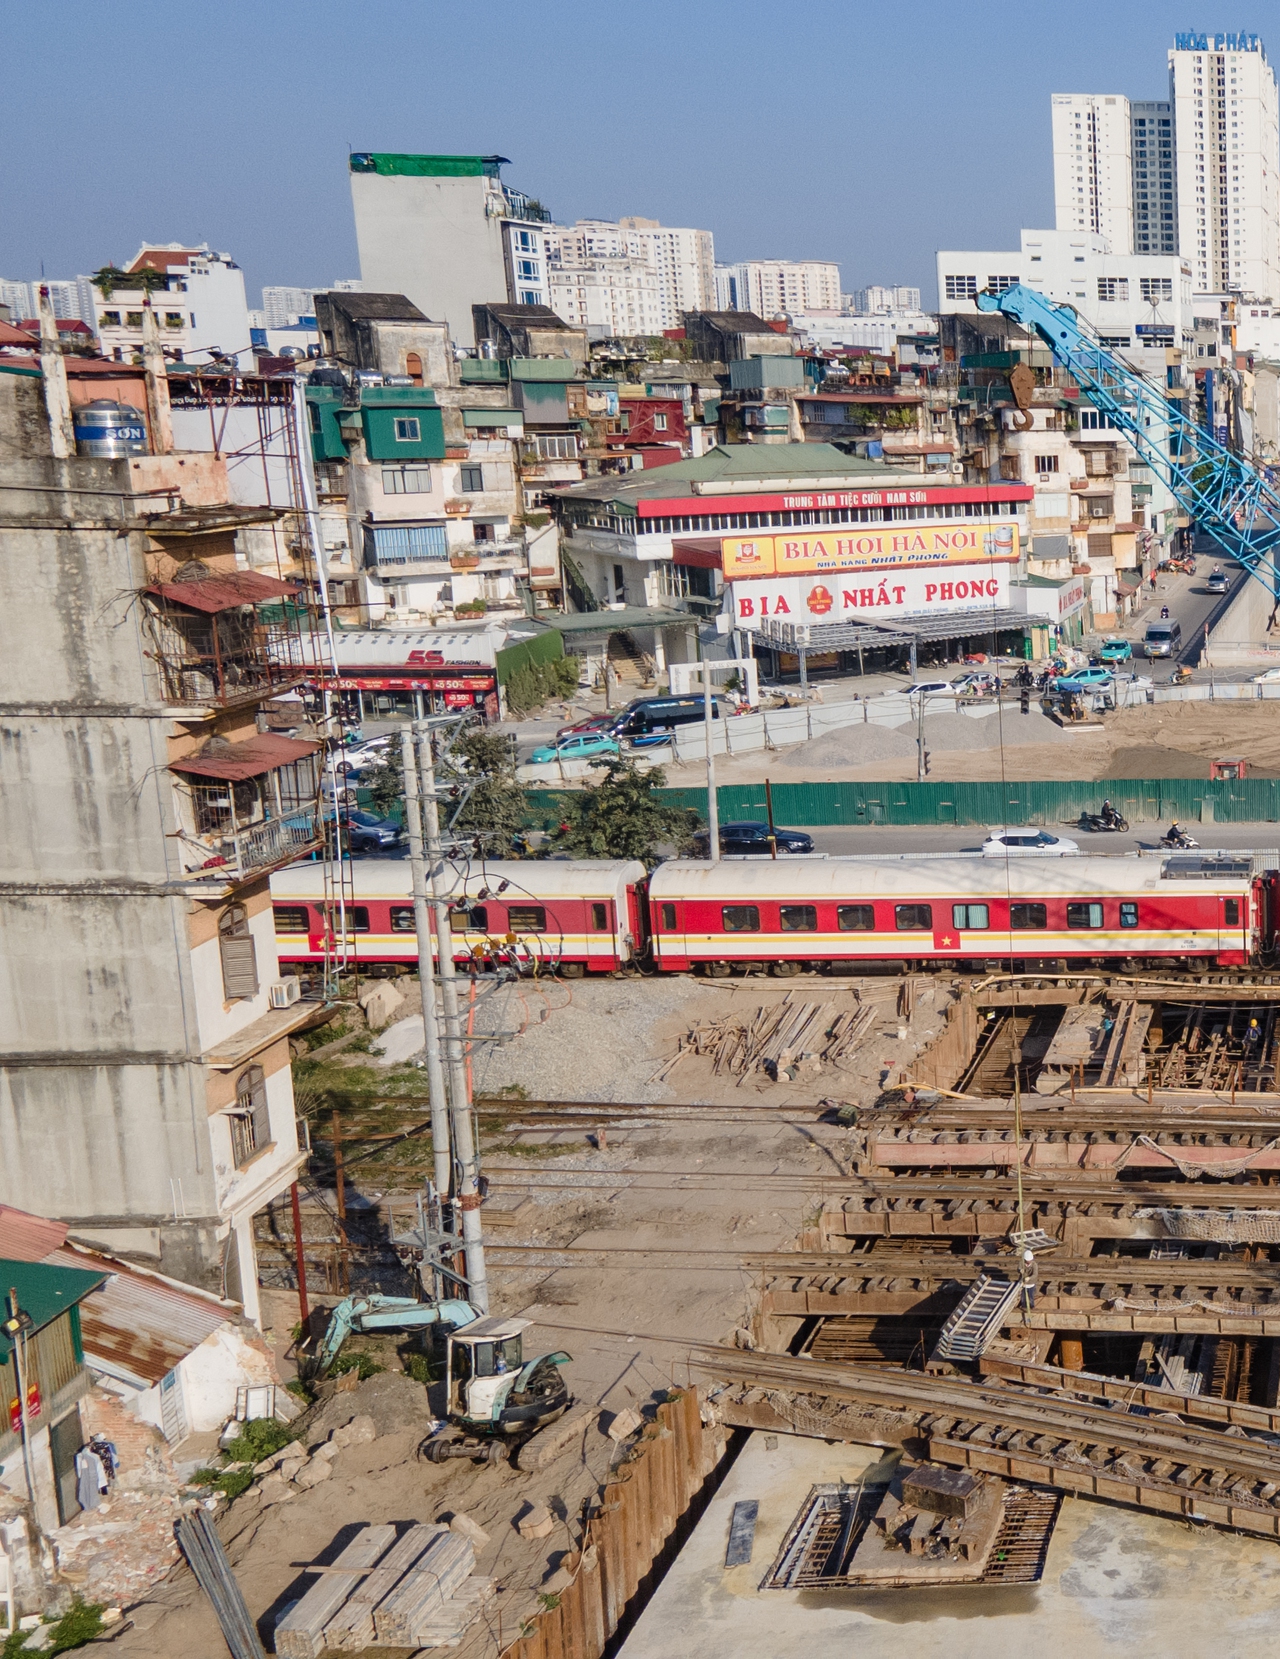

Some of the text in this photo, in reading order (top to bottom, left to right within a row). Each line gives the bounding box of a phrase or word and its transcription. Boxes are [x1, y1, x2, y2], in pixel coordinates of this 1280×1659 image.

[1176, 28, 1258, 52] HÒA PHÁT
[784, 496, 813, 508] TRUNG
[817, 493, 836, 507] TÂM
[840, 492, 859, 507] TIỆC
[887, 492, 907, 503] NAM
[784, 541, 828, 559] BIA
[892, 531, 926, 552] HÀ
[934, 529, 977, 551] NỘI
[907, 553, 948, 561] PHONG
[739, 578, 999, 618] BIA NHẤT PHONG
